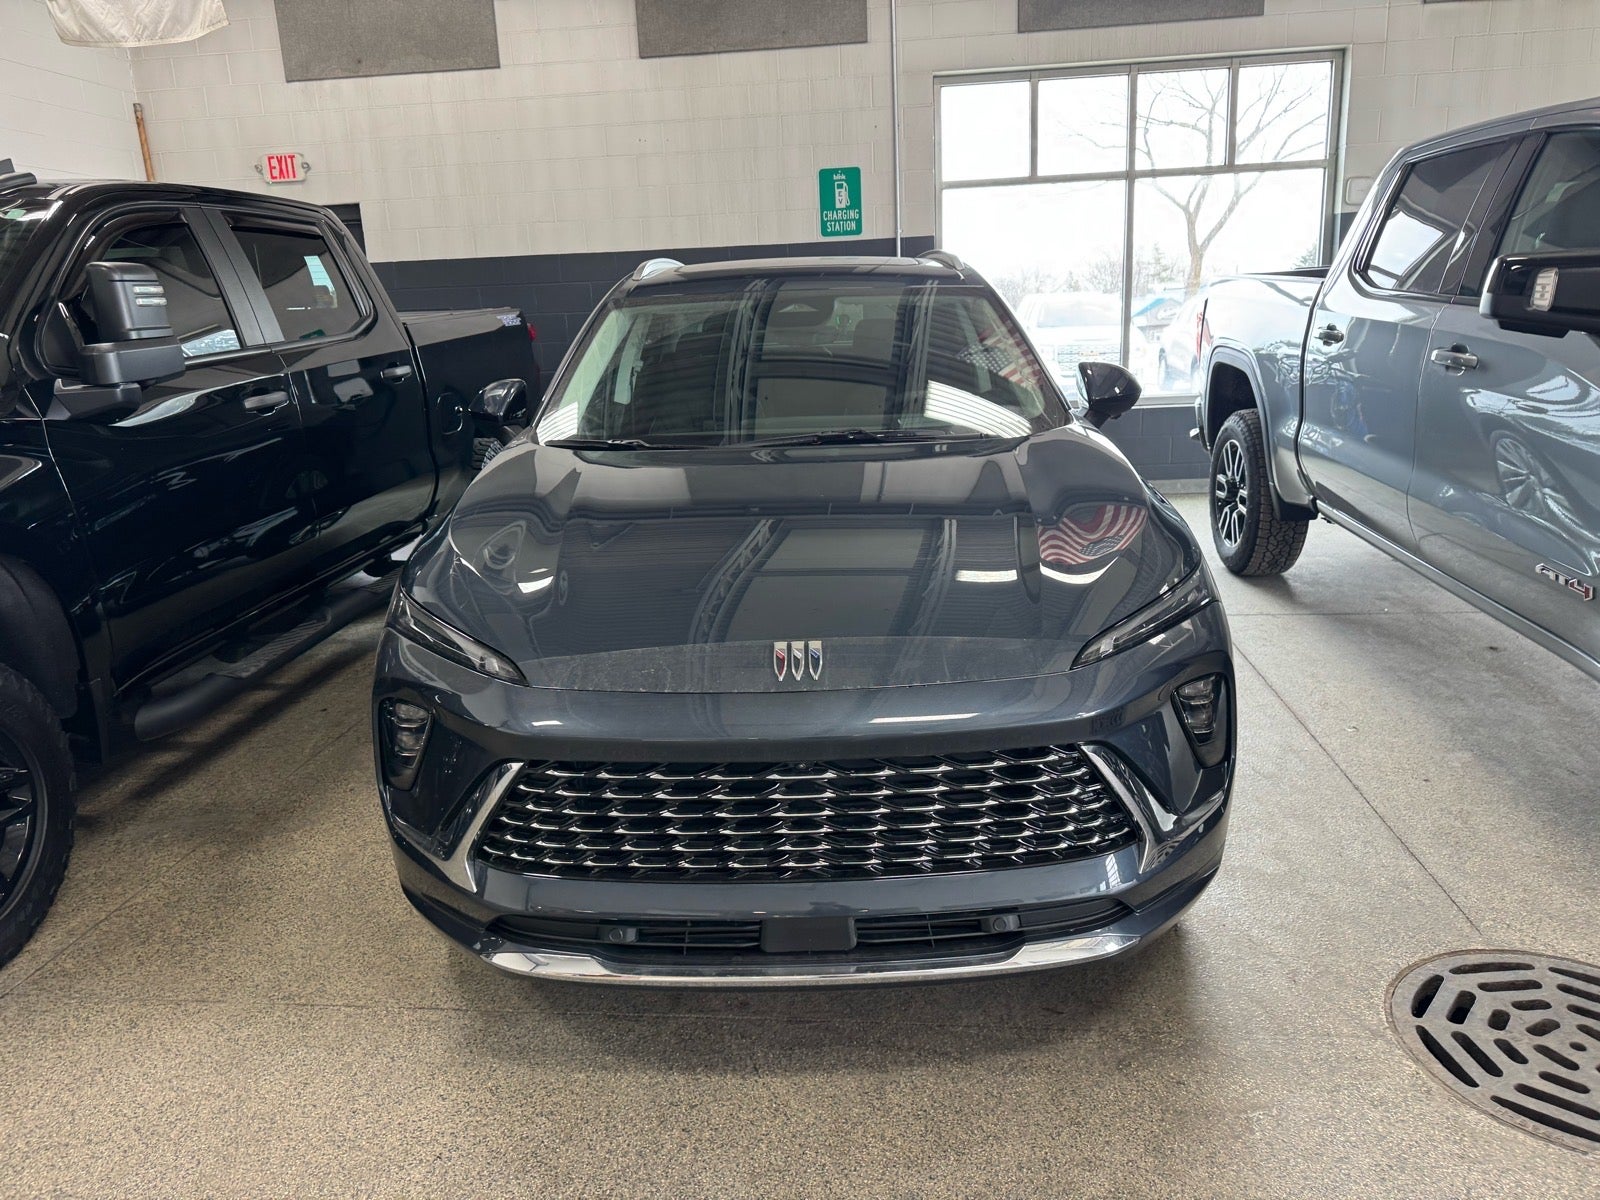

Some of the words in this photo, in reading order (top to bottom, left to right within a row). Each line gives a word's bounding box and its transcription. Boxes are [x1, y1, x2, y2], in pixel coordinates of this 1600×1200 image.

[267, 154, 296, 180] EXIT
[822, 209, 860, 221] CHARGING
[826, 220, 857, 232] STATION
[1535, 562, 1593, 601] AT4
